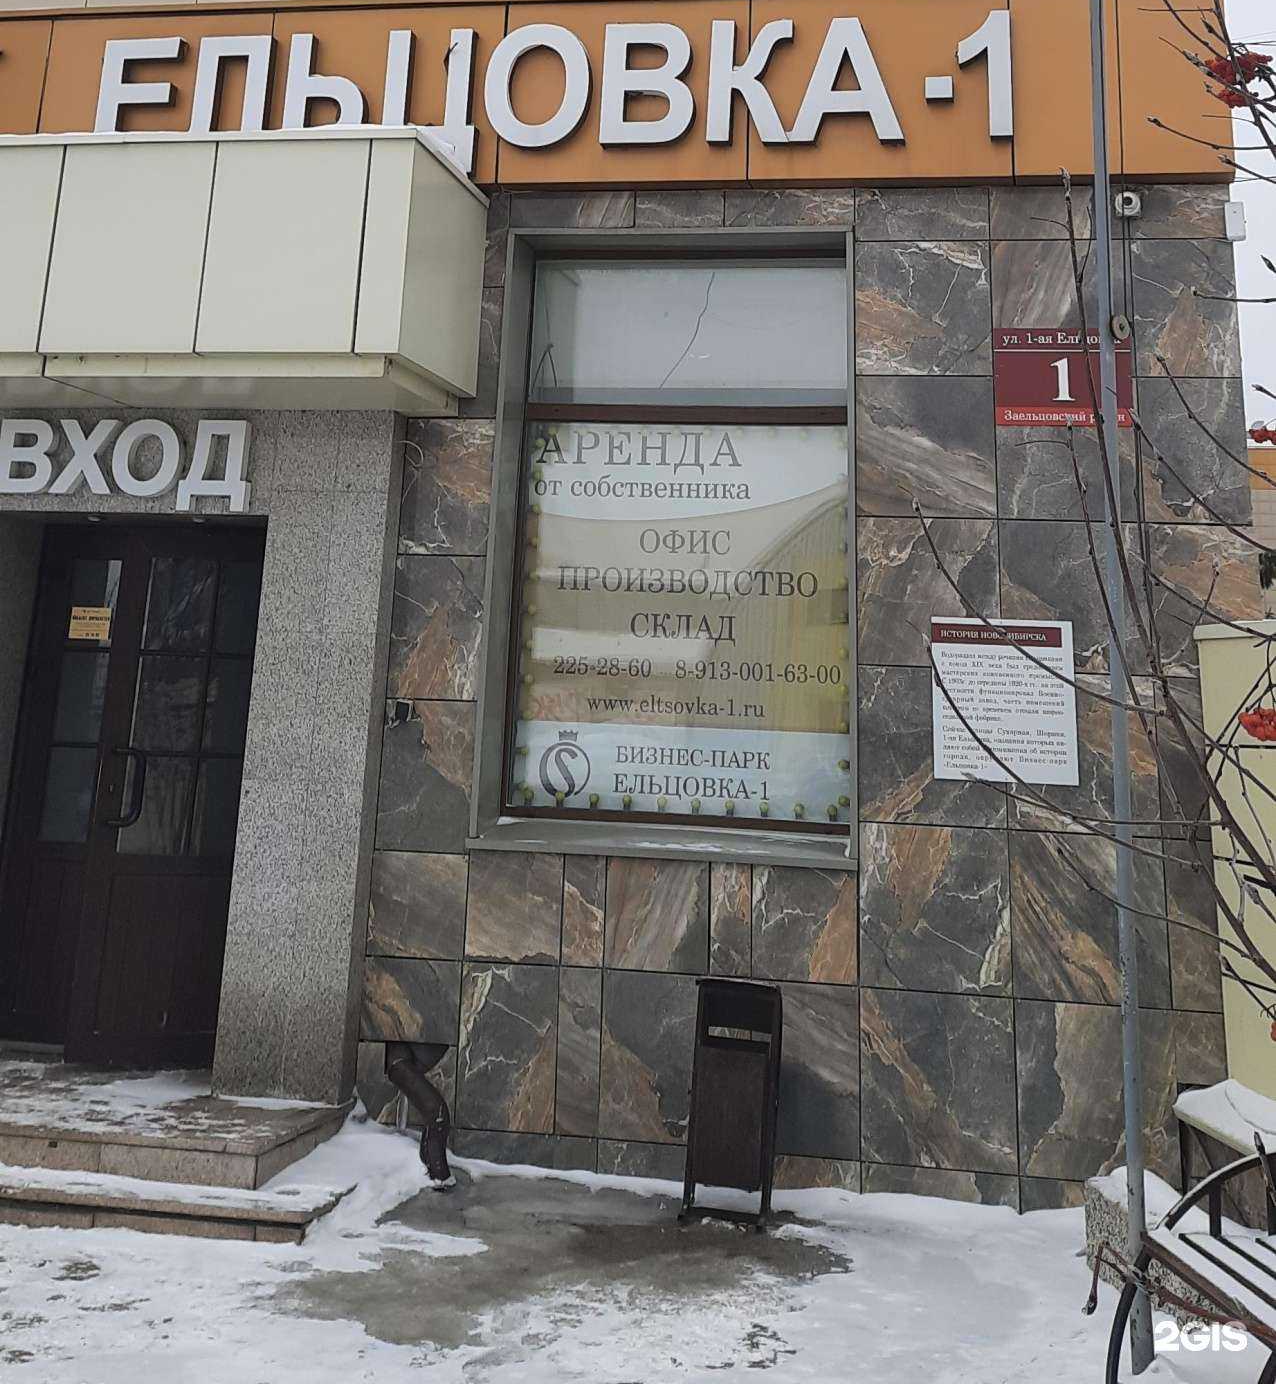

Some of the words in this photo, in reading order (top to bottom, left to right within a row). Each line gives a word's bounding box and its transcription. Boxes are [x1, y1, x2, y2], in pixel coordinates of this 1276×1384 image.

[1002, 334, 1021, 346] ул.
[1026, 332, 1053, 344] 1-ая
[1057, 332, 1121, 346] Елцоа
[1050, 357, 1076, 402] 1
[0, 418, 250, 512] ВХОД
[535, 430, 743, 475] АРЕНДА
[534, 479, 562, 496] от
[570, 473, 752, 501] собственника
[639, 527, 732, 555] ОФИС
[557, 566, 819, 602] ПРОИЗВОДСТВО
[629, 612, 737, 647] СКЛАД
[940, 629, 979, 639] ИСТОРИЯ
[980, 630, 1047, 642] НОВОИБИРСКА
[552, 654, 652, 678] 225-28-60
[675, 659, 842, 686] 8-913-001-63-00
[586, 693, 766, 718] www.eltsovka-1.ru
[615, 744, 771, 771] БИЗНЕС-ПАРК
[612, 773, 771, 802] ЕЛЬЦОВКА-1
